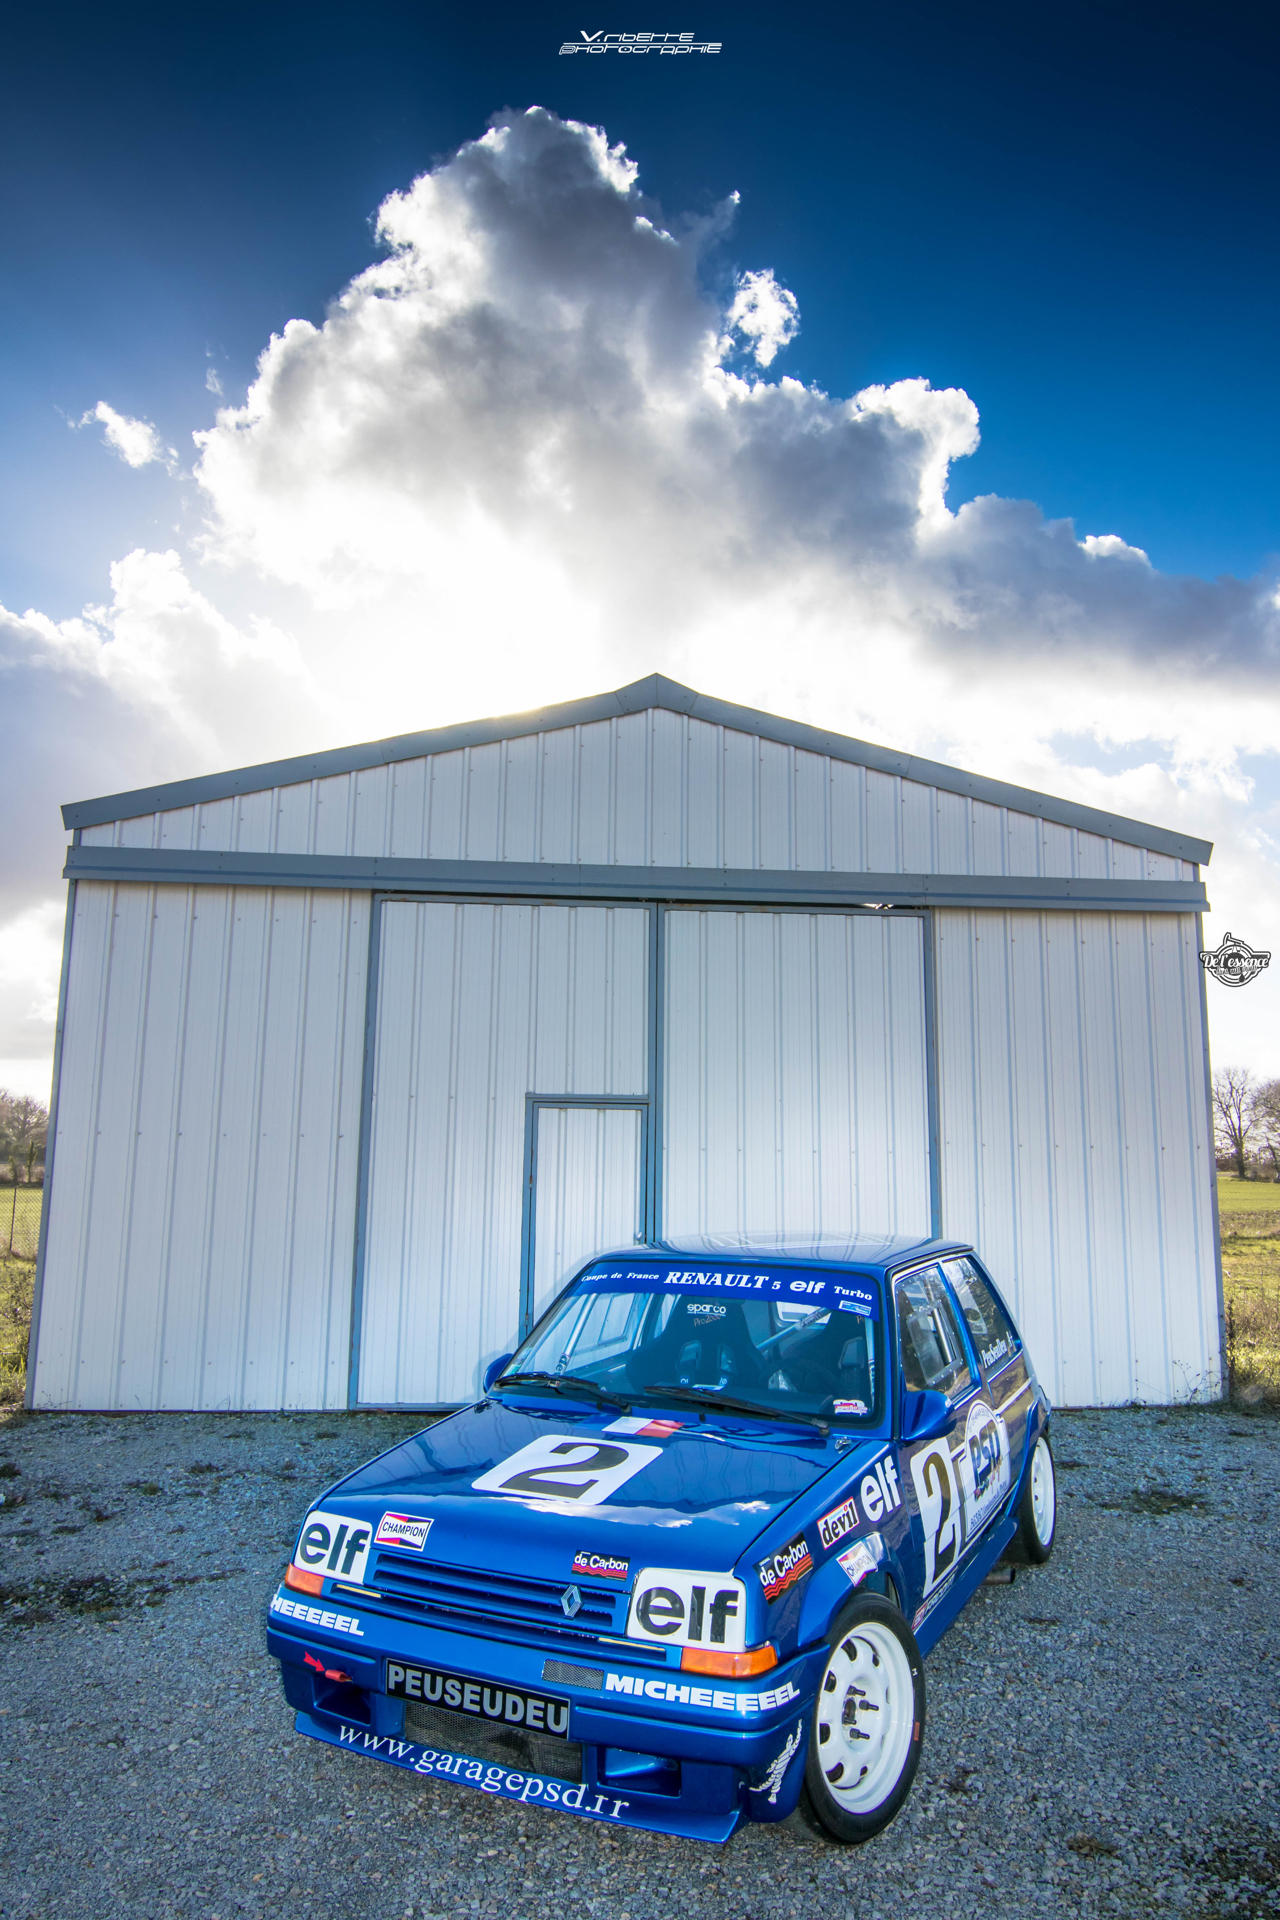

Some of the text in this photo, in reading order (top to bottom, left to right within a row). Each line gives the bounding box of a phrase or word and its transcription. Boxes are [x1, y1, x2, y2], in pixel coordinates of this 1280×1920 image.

[581, 1273, 608, 1282] Coupe
[626, 1272, 660, 1280] France
[663, 1271, 770, 1289] RENAULT
[771, 1281, 782, 1290] 5
[789, 1280, 827, 1294] elf
[834, 1286, 873, 1301] Turbo
[686, 1303, 727, 1315] sparco
[497, 1442, 630, 1499] 2
[861, 1455, 902, 1522] elf
[382, 1521, 426, 1537] CHAMPION
[822, 1501, 858, 1546] devil
[922, 1451, 957, 1585] 2
[299, 1522, 371, 1575] elf
[574, 1553, 629, 1571] de Carbon
[760, 1540, 809, 1587] de Carbon
[636, 1585, 740, 1644] elf
[388, 1663, 569, 1734] PEUSEUDEU
[605, 1673, 801, 1712] MICHEEEEEL
